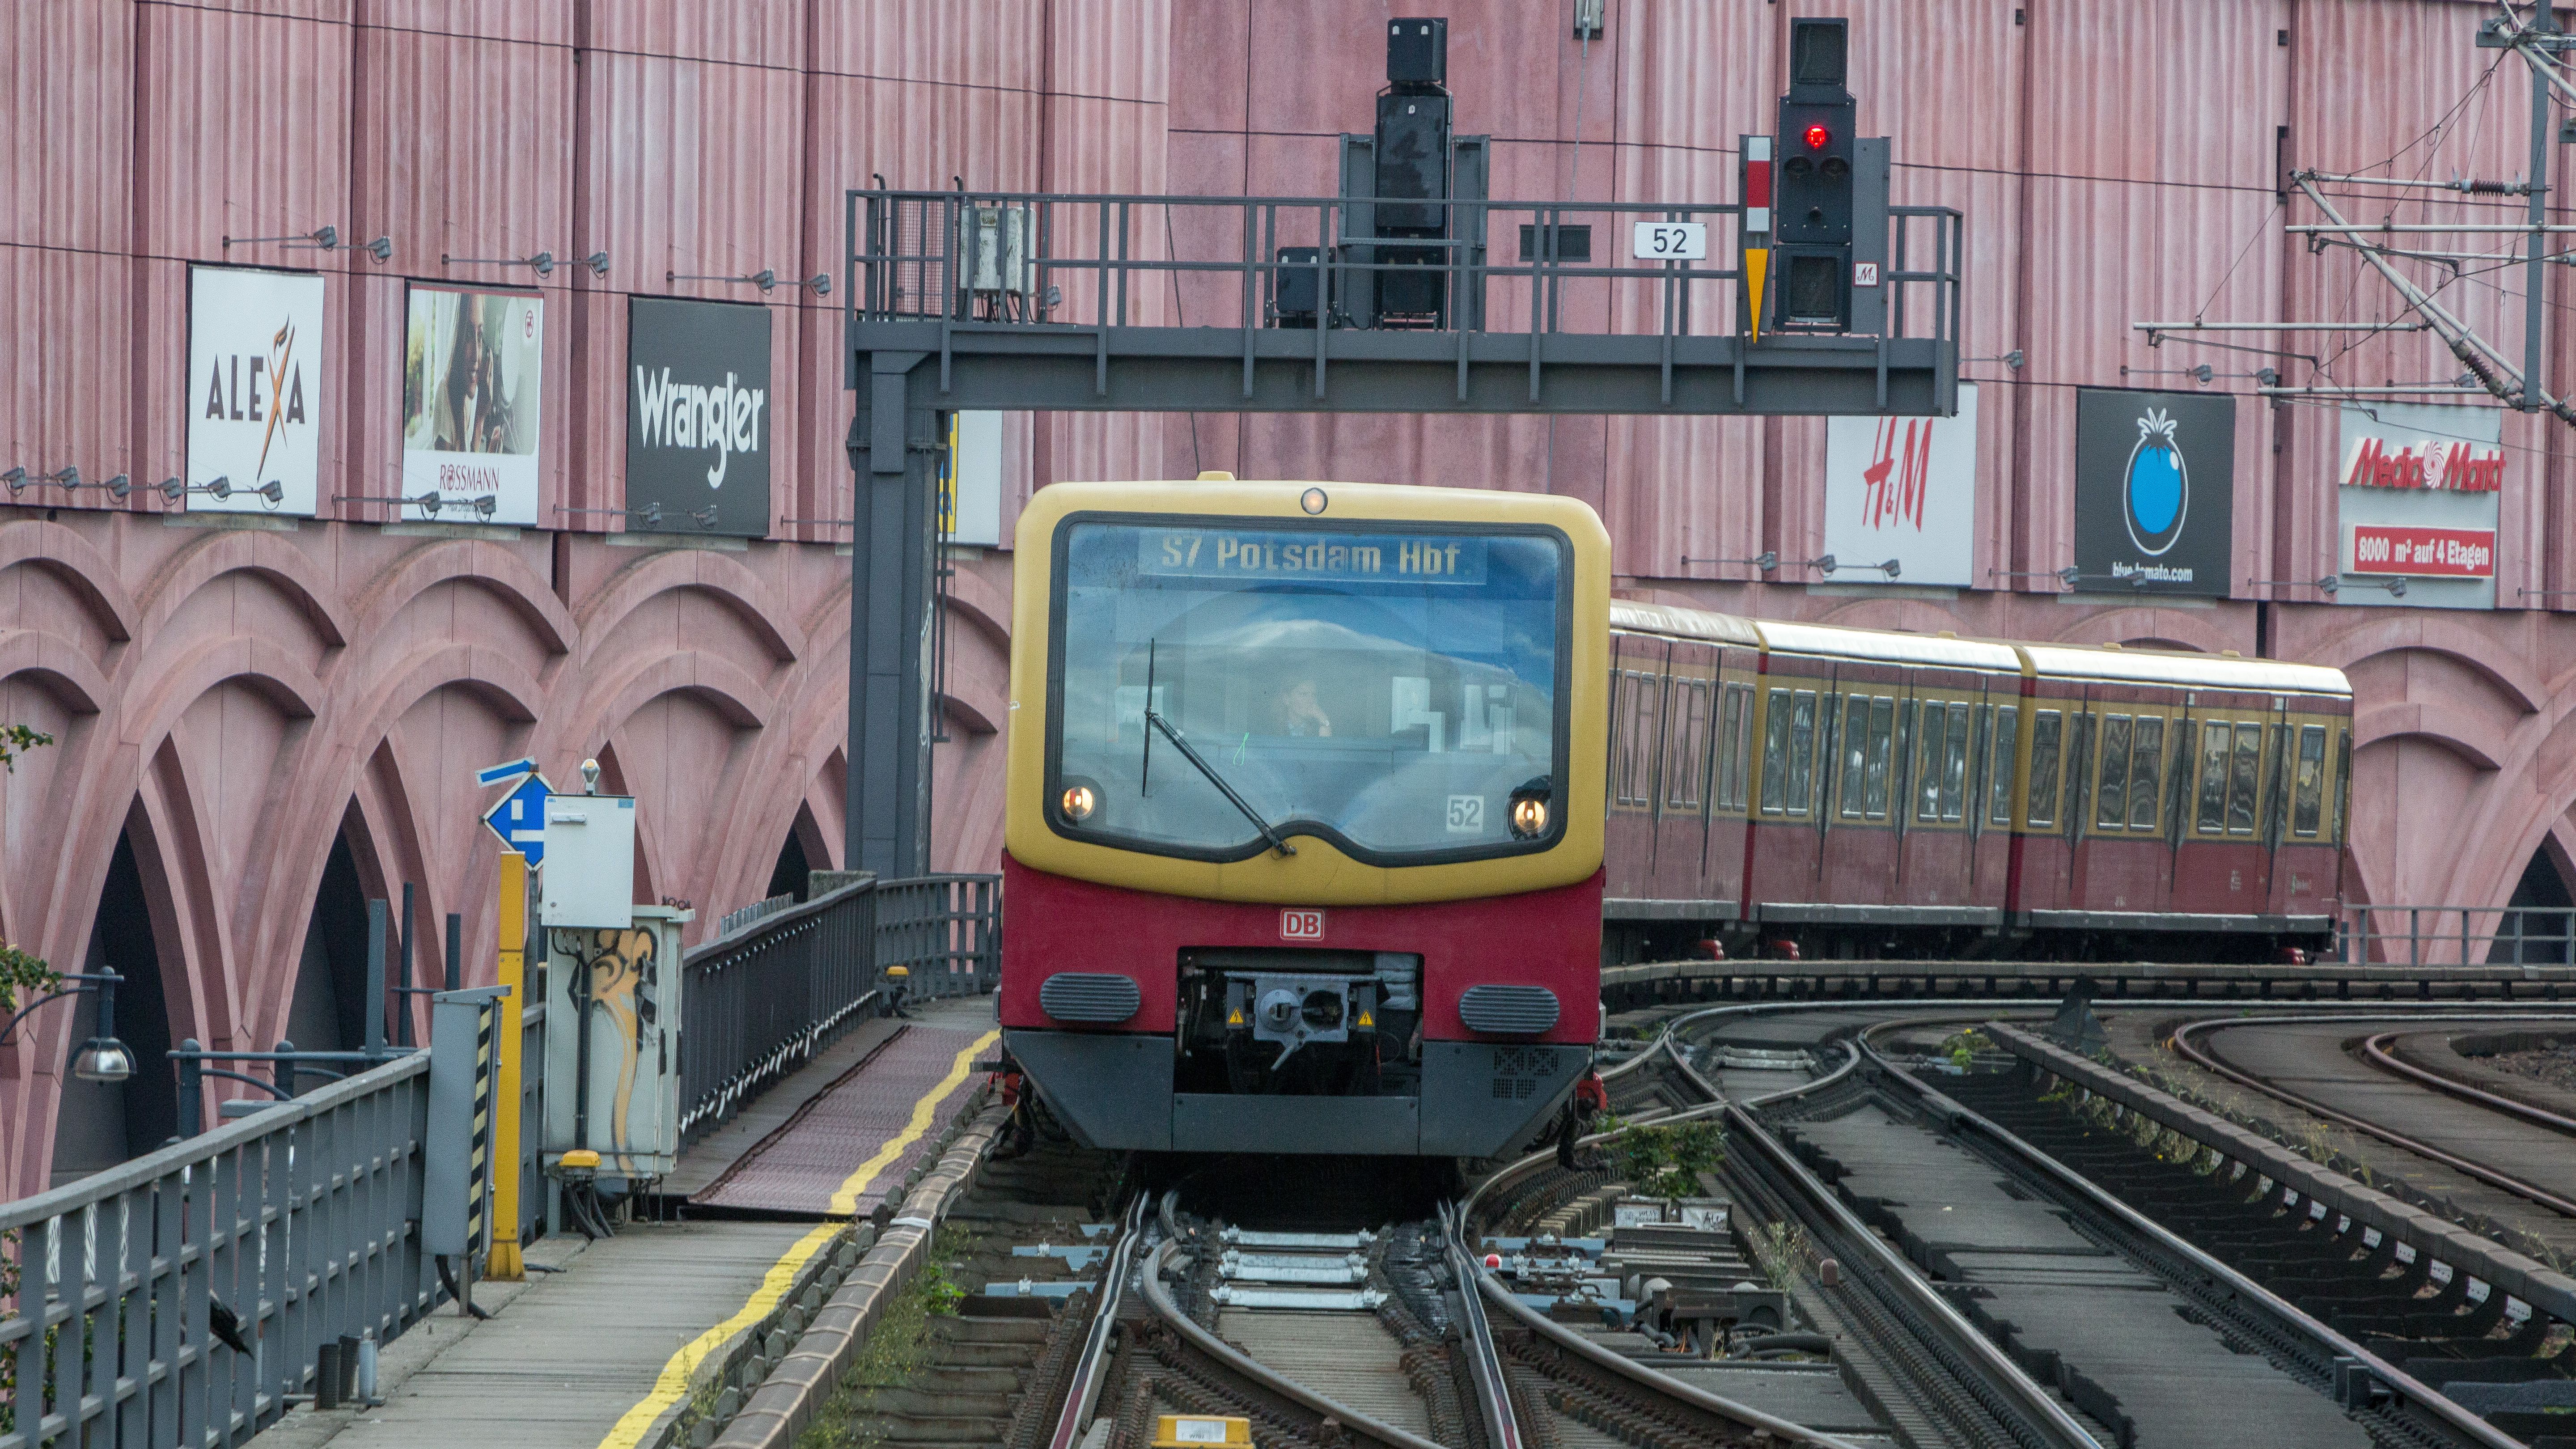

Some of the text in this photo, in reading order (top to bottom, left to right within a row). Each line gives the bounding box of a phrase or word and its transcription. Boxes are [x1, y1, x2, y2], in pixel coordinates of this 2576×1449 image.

[1653, 228, 1687, 253] 52
[1857, 266, 1874, 281] M
[206, 323, 305, 484] ALEXA
[636, 364, 764, 489] Wrangler
[440, 464, 500, 491] ROSSMANN
[1863, 415, 1933, 533] H&M
[2348, 437, 2507, 491] Media Markt
[1163, 535, 1461, 575] S7 Potsdam Hbf
[2359, 537, 2390, 562] 8000
[2415, 538, 2435, 564] auf
[2436, 540, 2445, 564] 4
[2448, 540, 2489, 571] Etagen
[1449, 799, 1480, 827] 52
[1286, 914, 1319, 934] DB
